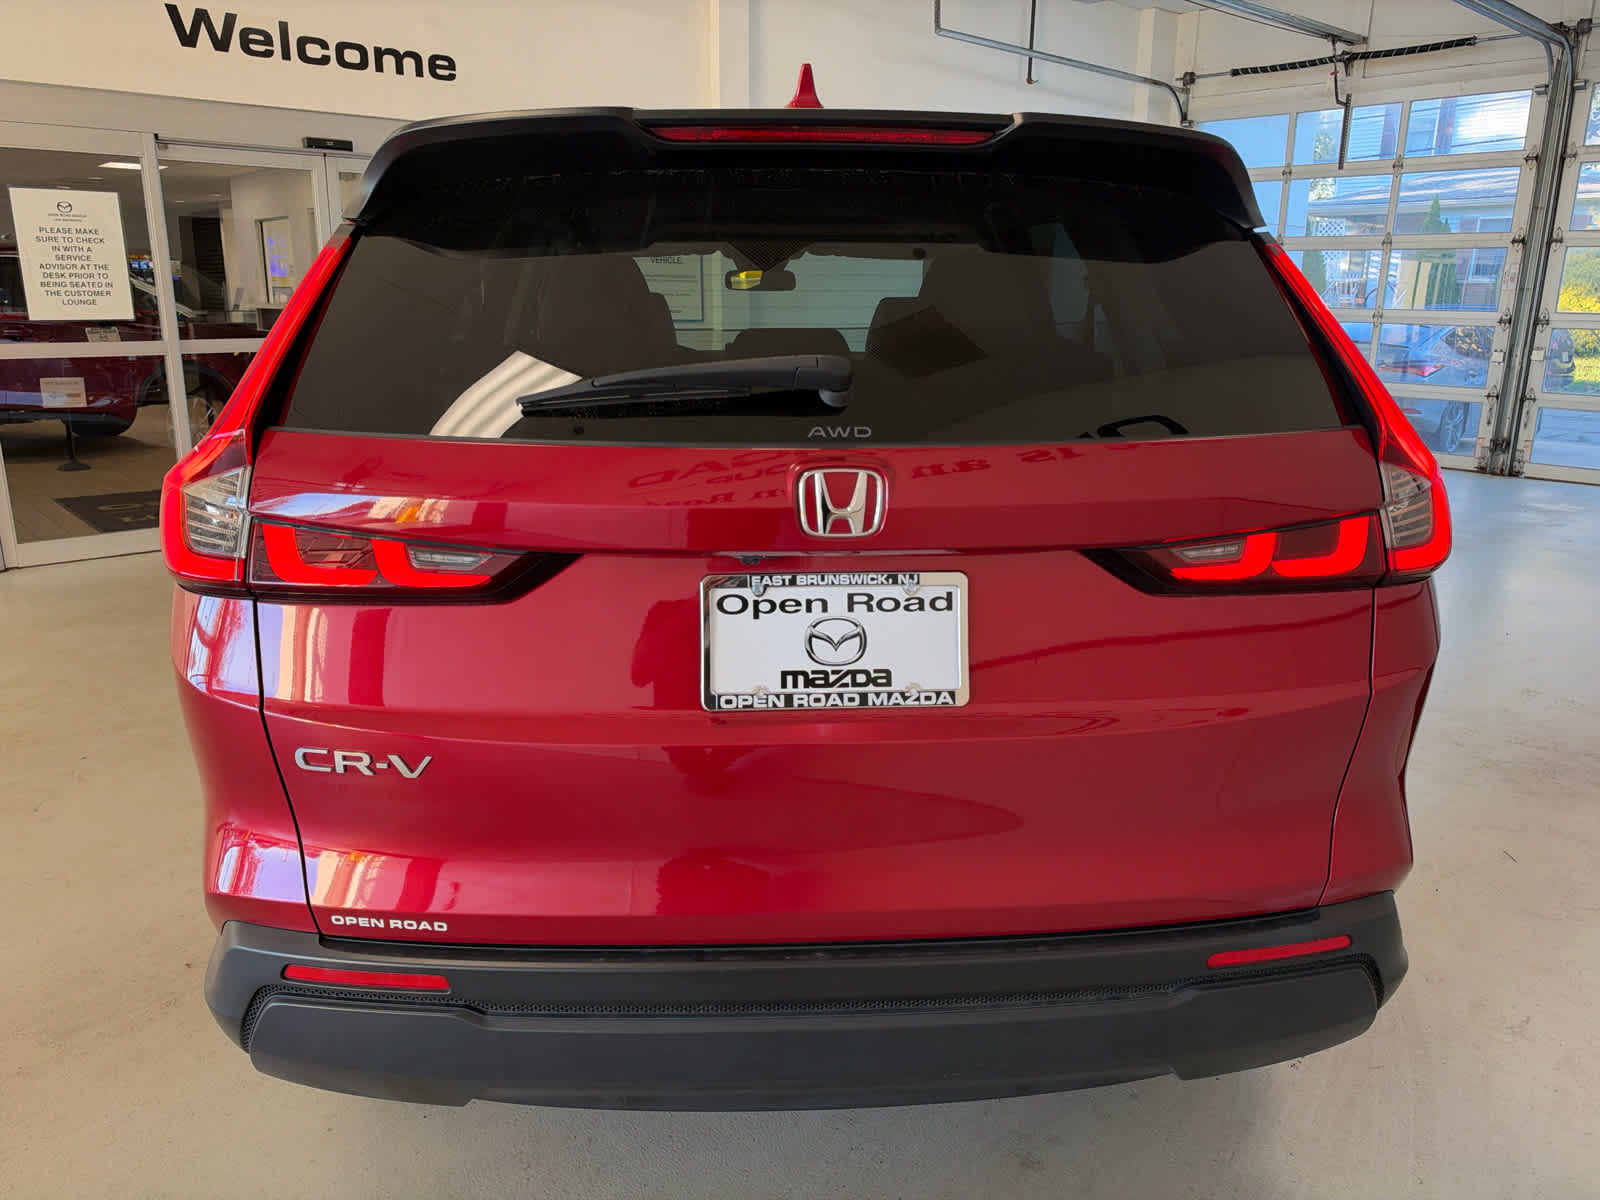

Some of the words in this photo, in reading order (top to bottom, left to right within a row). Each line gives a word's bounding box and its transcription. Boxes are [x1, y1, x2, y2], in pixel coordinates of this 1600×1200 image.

[164, 3, 457, 82] Welcome
[38, 226, 73, 235] PLEASE
[75, 227, 100, 235] MAKE
[35, 235, 60, 243] SURE
[76, 236, 105, 244] CHECK
[39, 263, 78, 271] ADVISOR
[80, 263, 91, 271] AT
[42, 271, 67, 279] DESK
[97, 272, 109, 280] TO
[69, 281, 103, 289] SEATED
[64, 290, 112, 298] CUSTOMER
[62, 298, 97, 306] LOUNGE
[807, 426, 872, 438] AWD
[752, 575, 792, 587] EAST
[797, 574, 893, 586] BRUNSWICK,
[898, 574, 919, 586] NJ
[716, 594, 829, 620] Open
[847, 591, 953, 614] Road
[720, 694, 785, 709] OPEN
[793, 693, 860, 708] ROAD
[867, 691, 955, 706] MAZDA
[294, 747, 433, 779] CR-V
[330, 915, 385, 928] OPEN
[389, 919, 448, 932] ROAD
